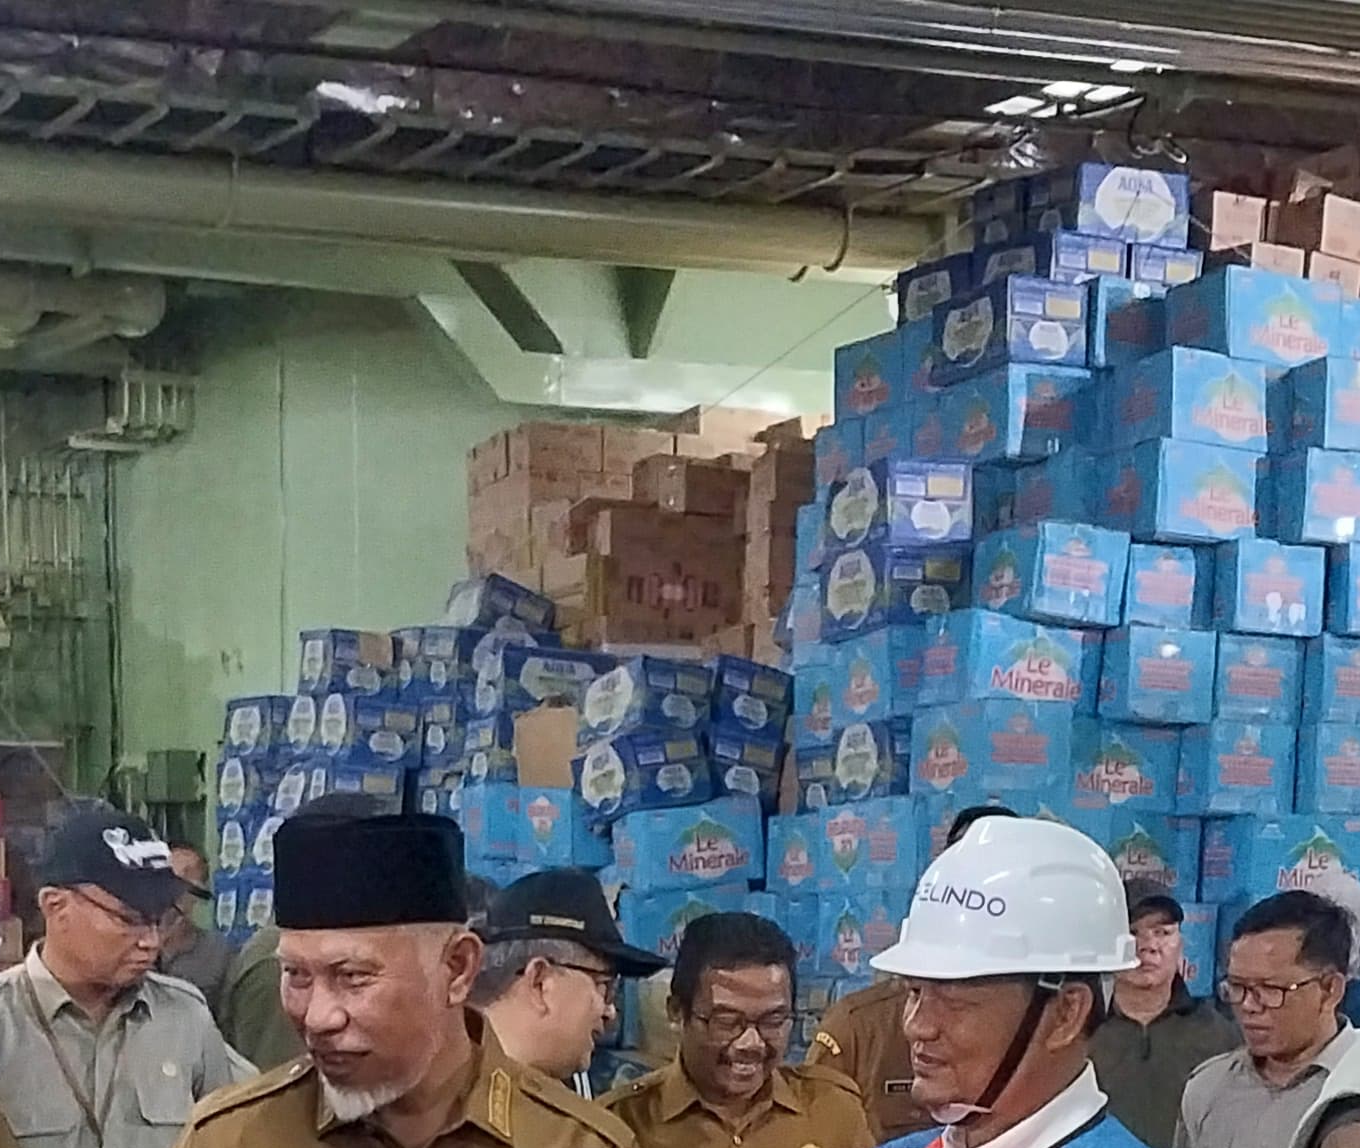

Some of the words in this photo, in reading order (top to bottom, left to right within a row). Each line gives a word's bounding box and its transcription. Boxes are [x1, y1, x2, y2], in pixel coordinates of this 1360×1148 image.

[1027, 654, 1052, 675] Le
[991, 668, 1082, 700] Minerale
[1104, 757, 1125, 777] Le
[1076, 771, 1154, 796] Minerale
[696, 833, 719, 852] Le
[669, 848, 750, 874] Minerale
[1307, 846, 1329, 870] Le
[915, 882, 1006, 917] ELINDO
